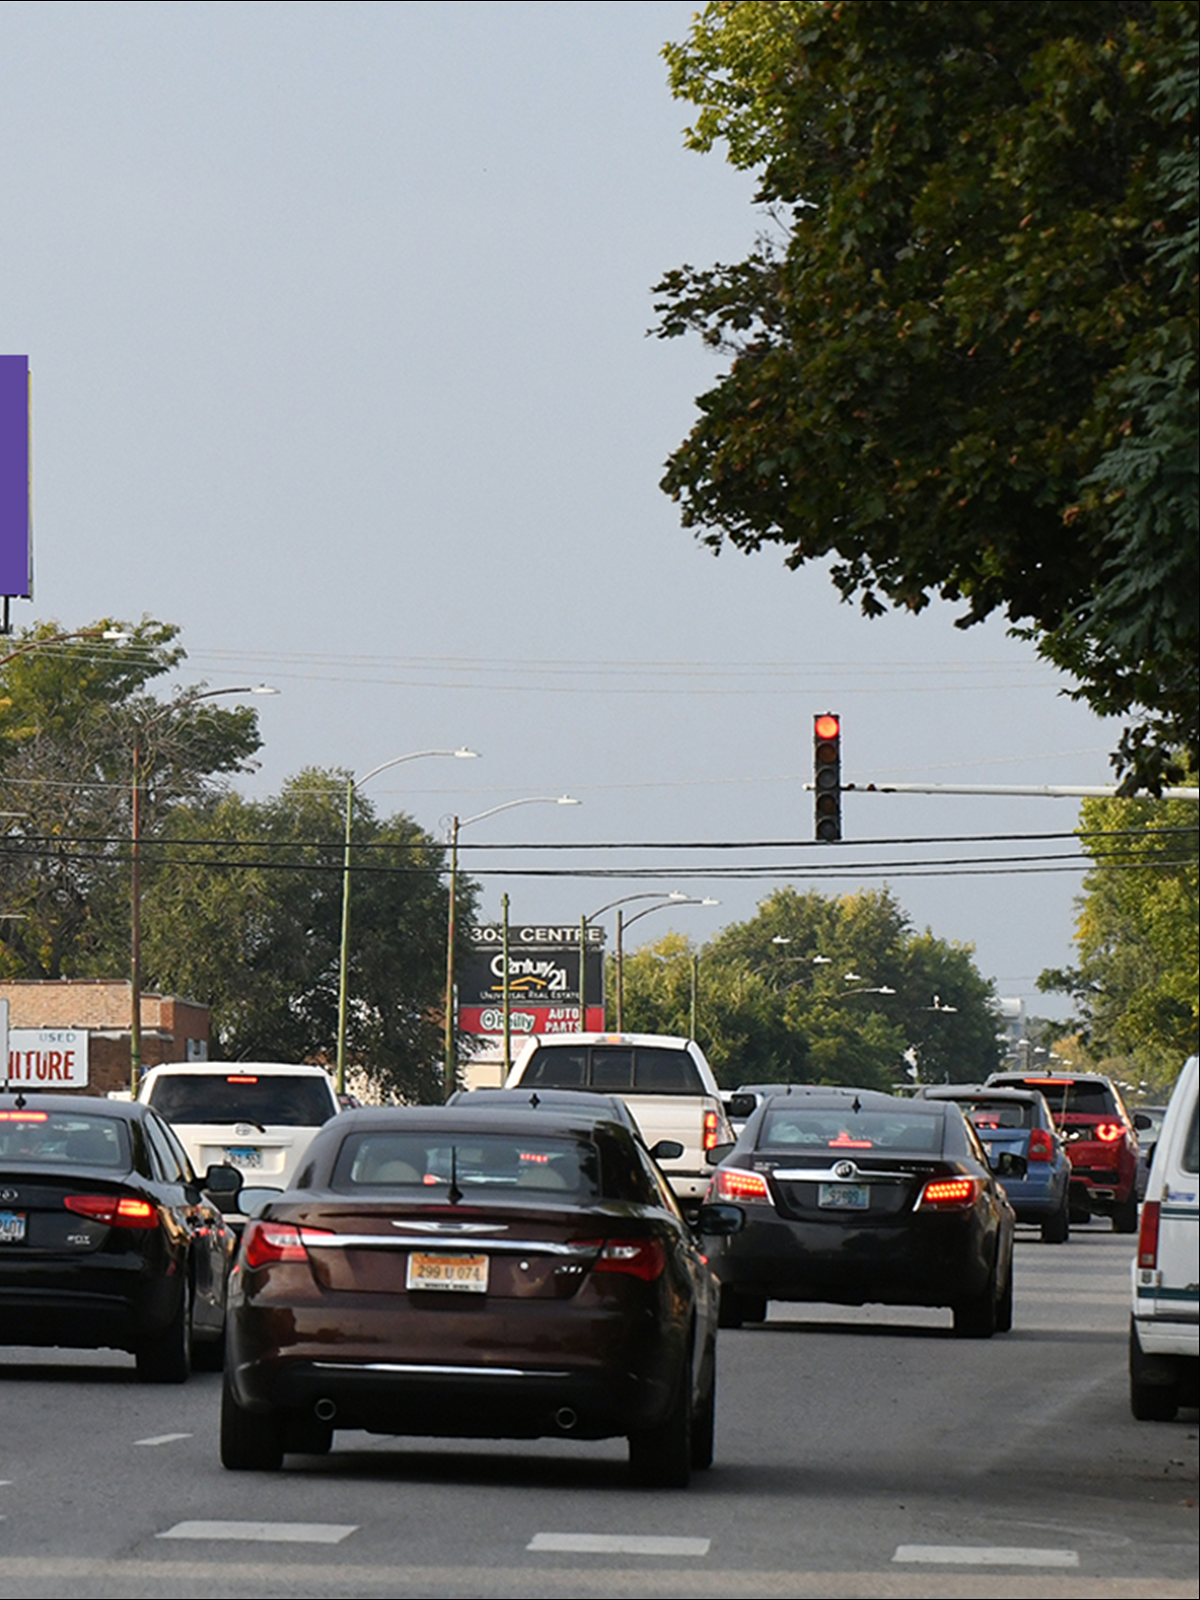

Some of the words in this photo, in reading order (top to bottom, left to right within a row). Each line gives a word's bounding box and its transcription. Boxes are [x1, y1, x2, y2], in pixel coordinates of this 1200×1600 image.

[548, 969, 567, 990] 21
[548, 1008, 580, 1020] AUTO
[545, 1021, 581, 1033] PARTS
[39, 1032, 76, 1043] USED
